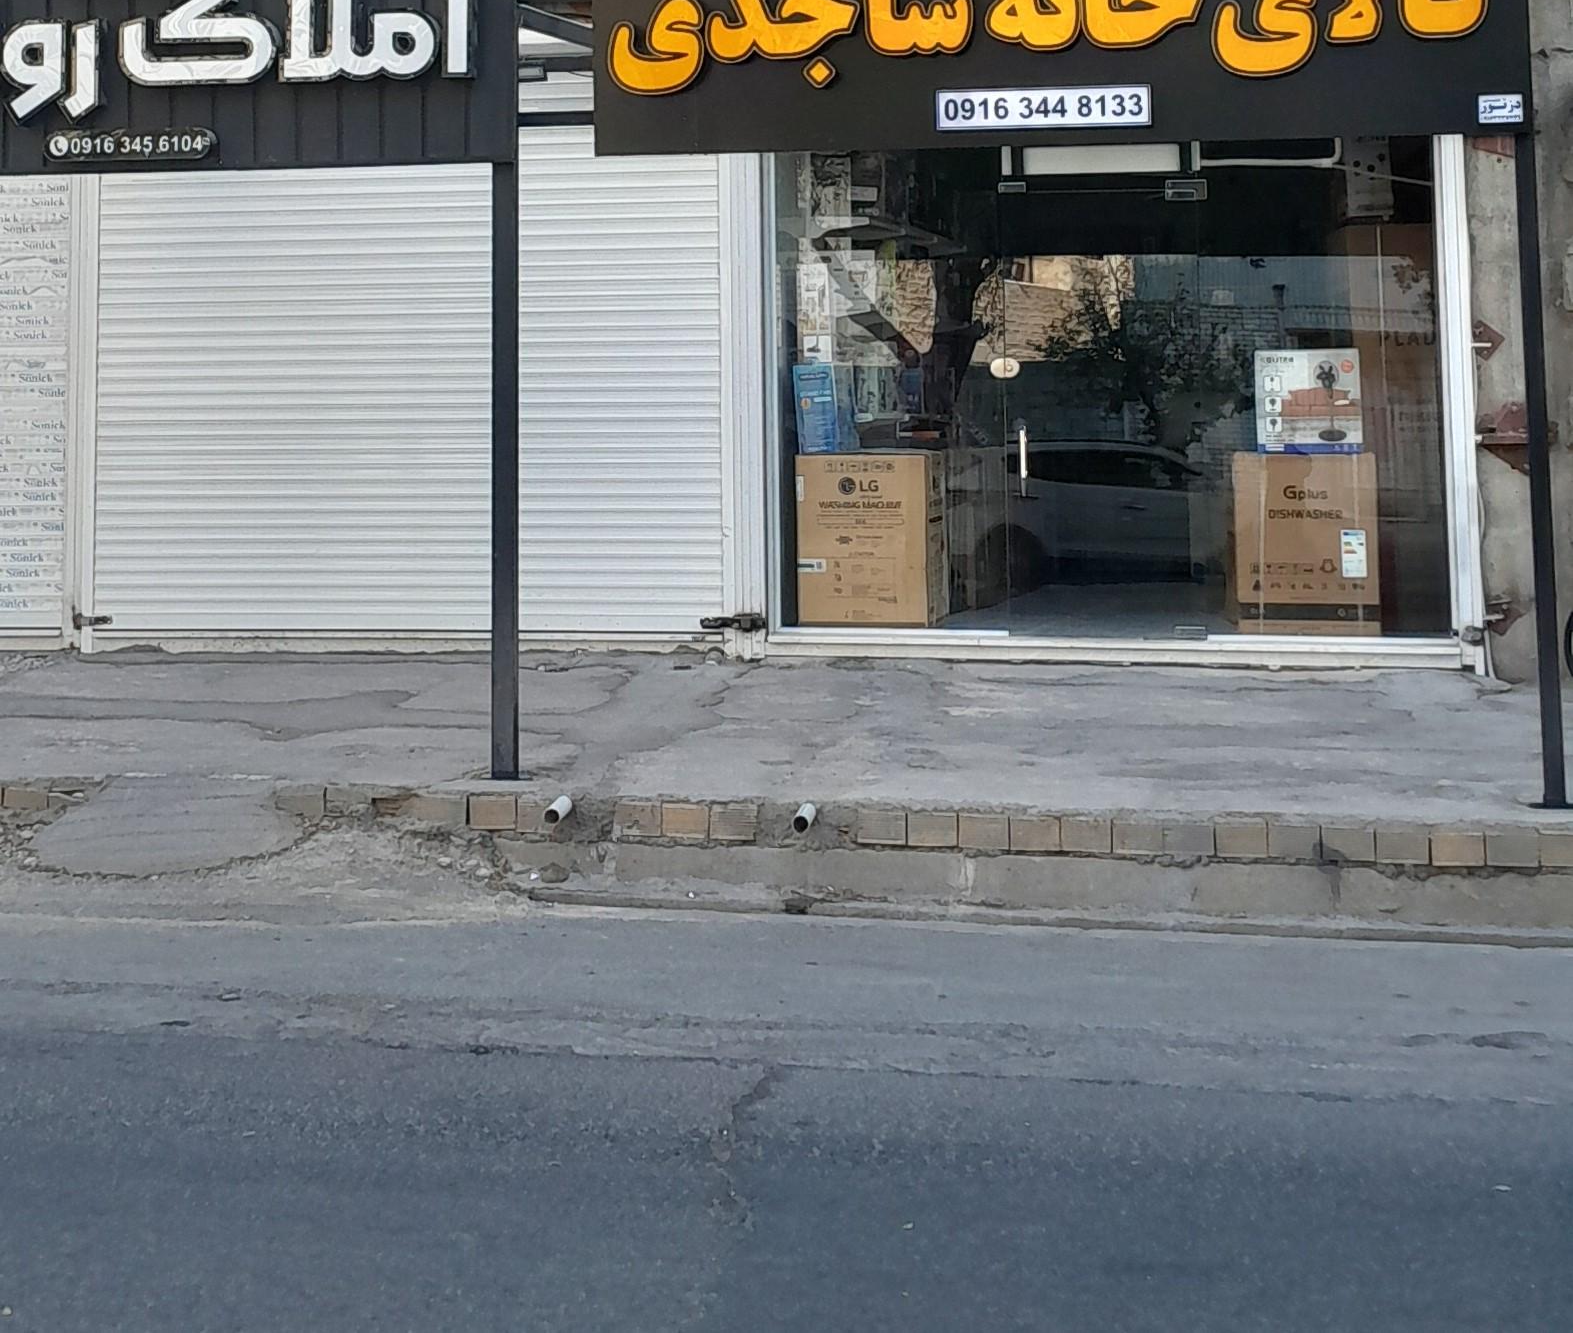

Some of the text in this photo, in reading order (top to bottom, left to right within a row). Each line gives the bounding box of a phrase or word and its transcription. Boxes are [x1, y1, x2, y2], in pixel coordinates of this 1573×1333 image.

[944, 93, 1144, 121] 0916 344 8133
[70, 136, 115, 154] 0916
[120, 136, 153, 153] 345
[158, 135, 203, 153] 6104
[859, 479, 879, 493] LG
[1283, 484, 1329, 502] Gplus
[1268, 508, 1344, 520] DISHWASHER
